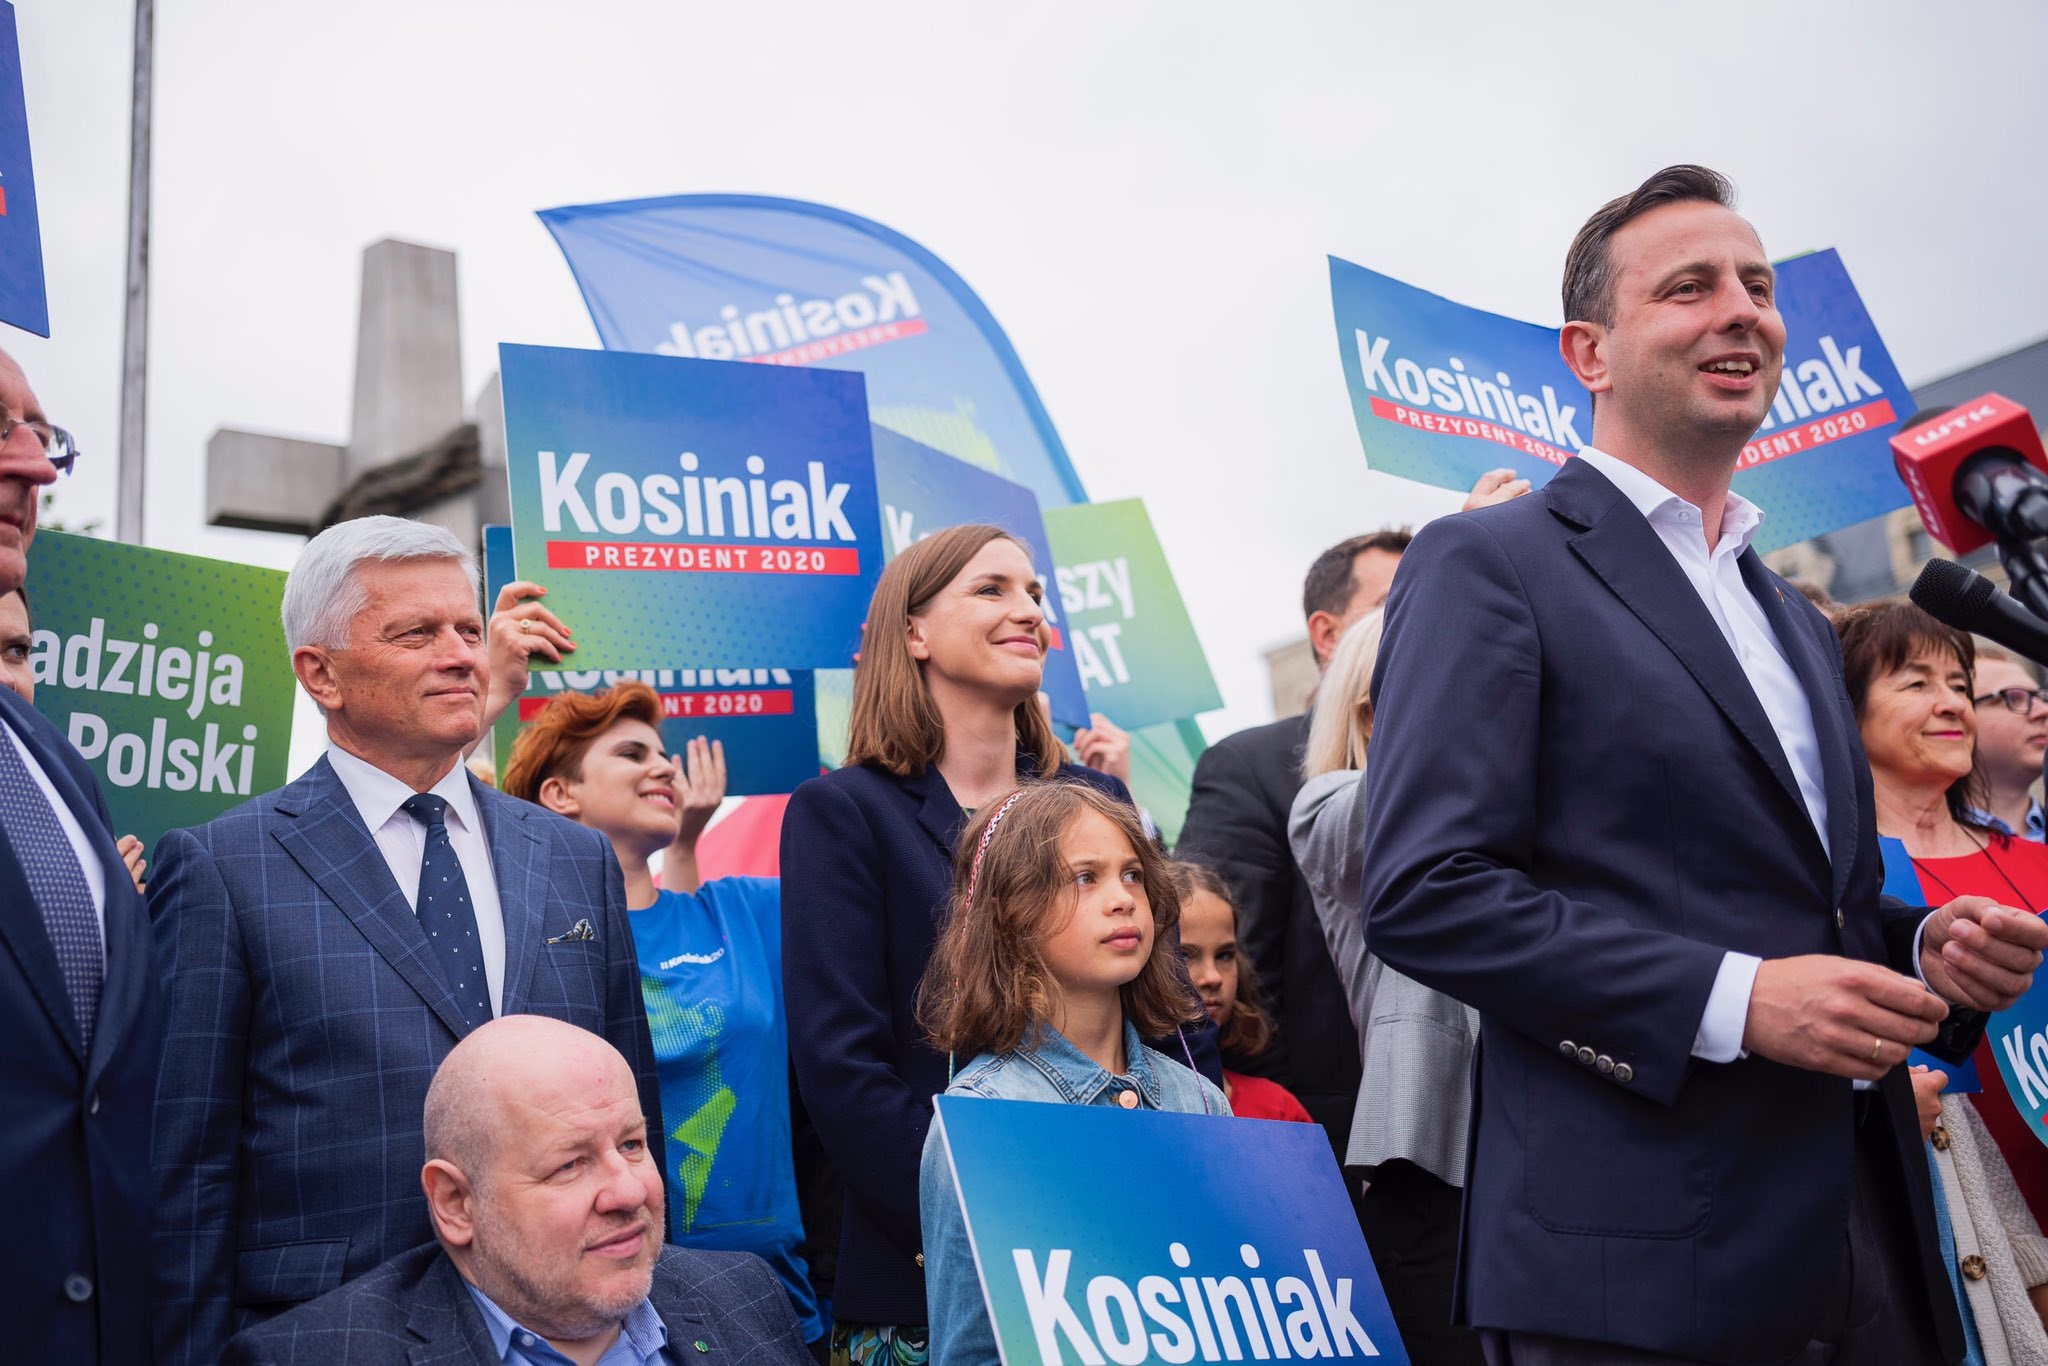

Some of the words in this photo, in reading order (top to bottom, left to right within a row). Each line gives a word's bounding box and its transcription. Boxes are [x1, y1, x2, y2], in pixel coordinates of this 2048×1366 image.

[1355, 328, 1584, 450] Kosiniak
[1395, 406, 1517, 446] PREZYDENT
[1809, 411, 1867, 443] 2020
[537, 450, 857, 541] Kosiniak
[585, 545, 748, 570] PREZYDENT
[760, 549, 826, 572] 2020
[703, 694, 764, 714] 2020
[67, 711, 258, 796] Polski
[1012, 1241, 1381, 1366] Kosiniak
